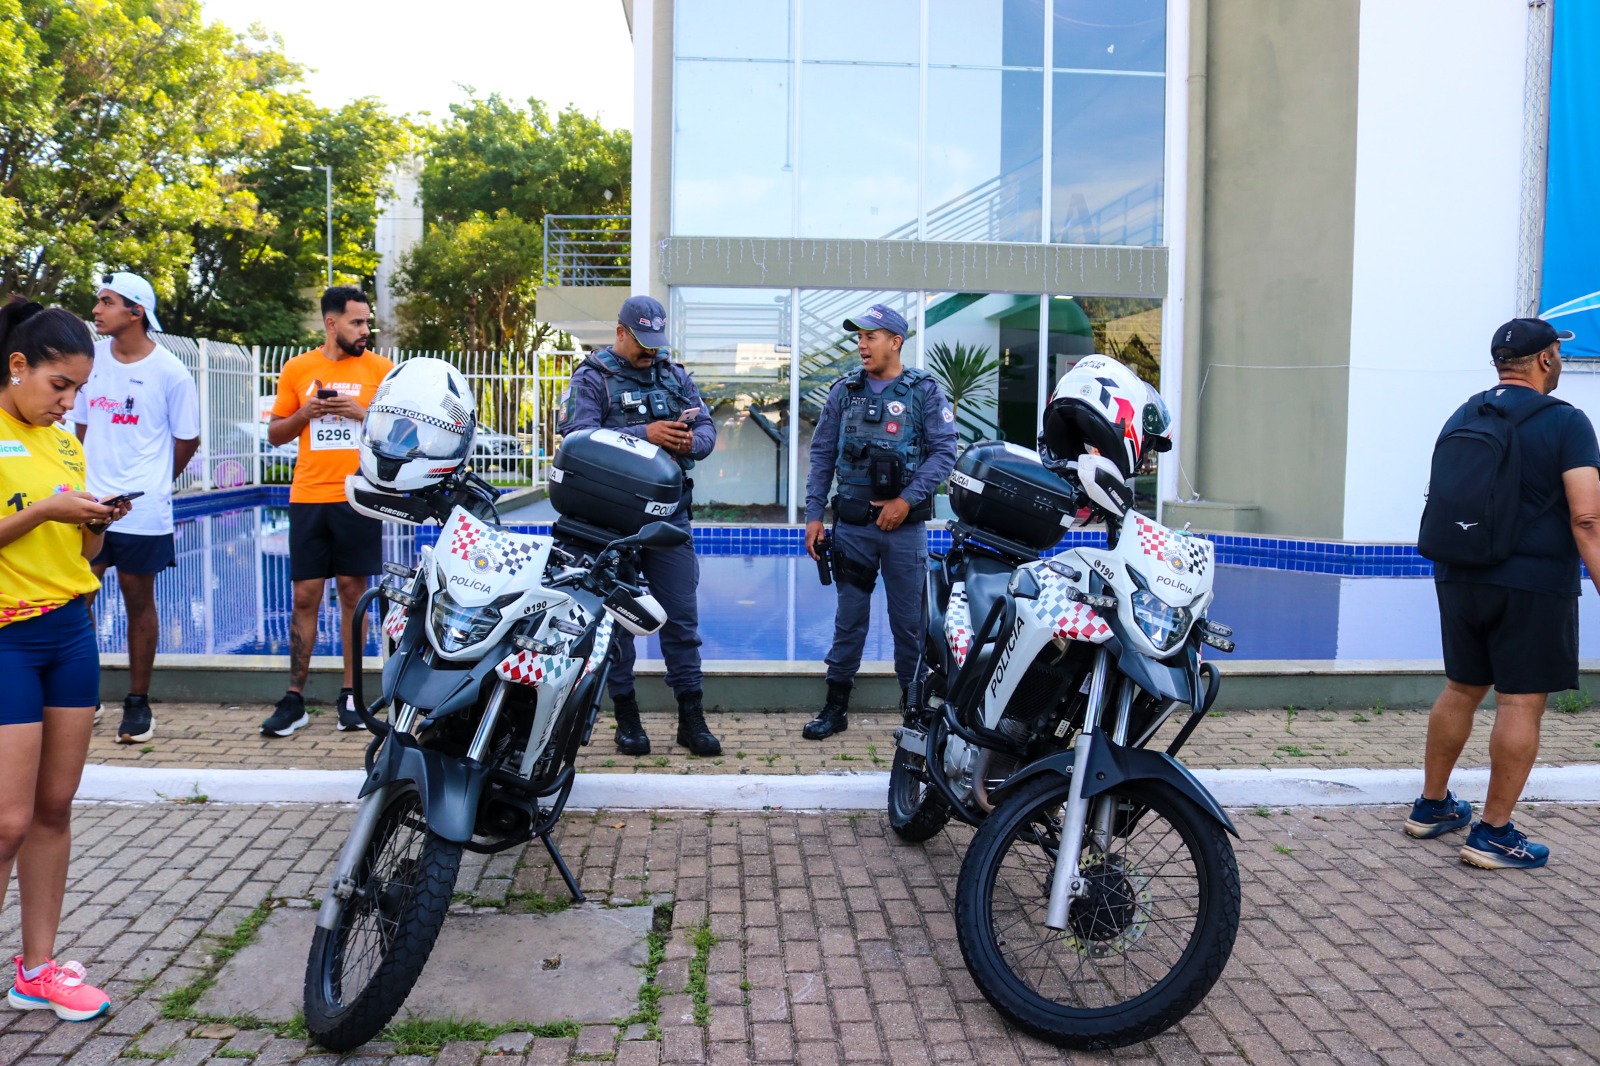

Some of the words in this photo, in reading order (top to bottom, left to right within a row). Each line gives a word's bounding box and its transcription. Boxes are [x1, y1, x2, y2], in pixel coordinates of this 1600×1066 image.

[111, 413, 139, 425] RUN
[317, 429, 351, 442] 6296
[380, 506, 410, 518] CIRCUIT
[1100, 564, 1115, 580] 190
[450, 575, 492, 594] POLÍCIA
[1156, 575, 1192, 595] POLÍCIA
[532, 600, 547, 612] 190
[616, 606, 640, 622] CIRCUIT
